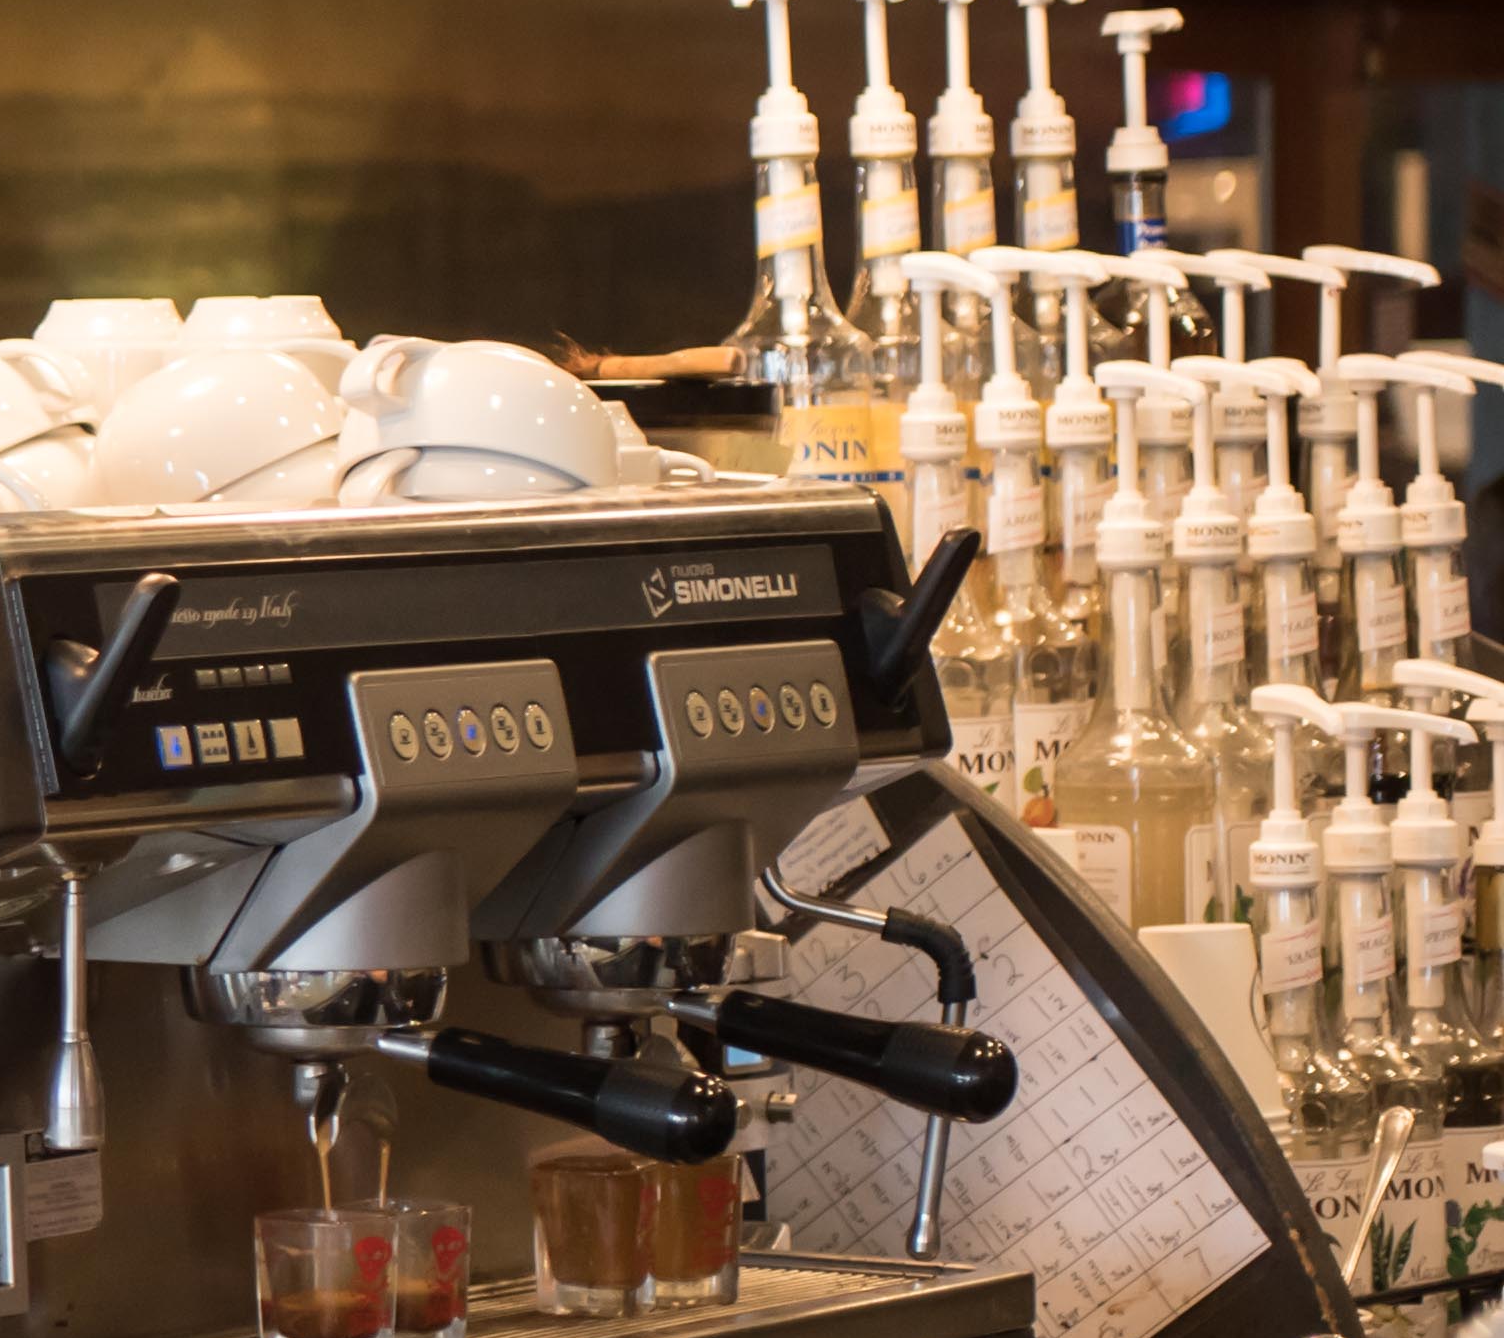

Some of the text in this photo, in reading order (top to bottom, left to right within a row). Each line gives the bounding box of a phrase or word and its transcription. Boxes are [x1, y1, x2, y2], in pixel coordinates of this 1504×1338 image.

[801, 439, 870, 462] NIN
[670, 563, 715, 577] nuova
[674, 574, 798, 604] SIMONELLI
[1252, 852, 1309, 865] MONIN
[798, 935, 837, 975] 12
[992, 952, 1024, 986] 2
[833, 962, 867, 1002] 3
[1183, 1245, 1213, 1278] 7
